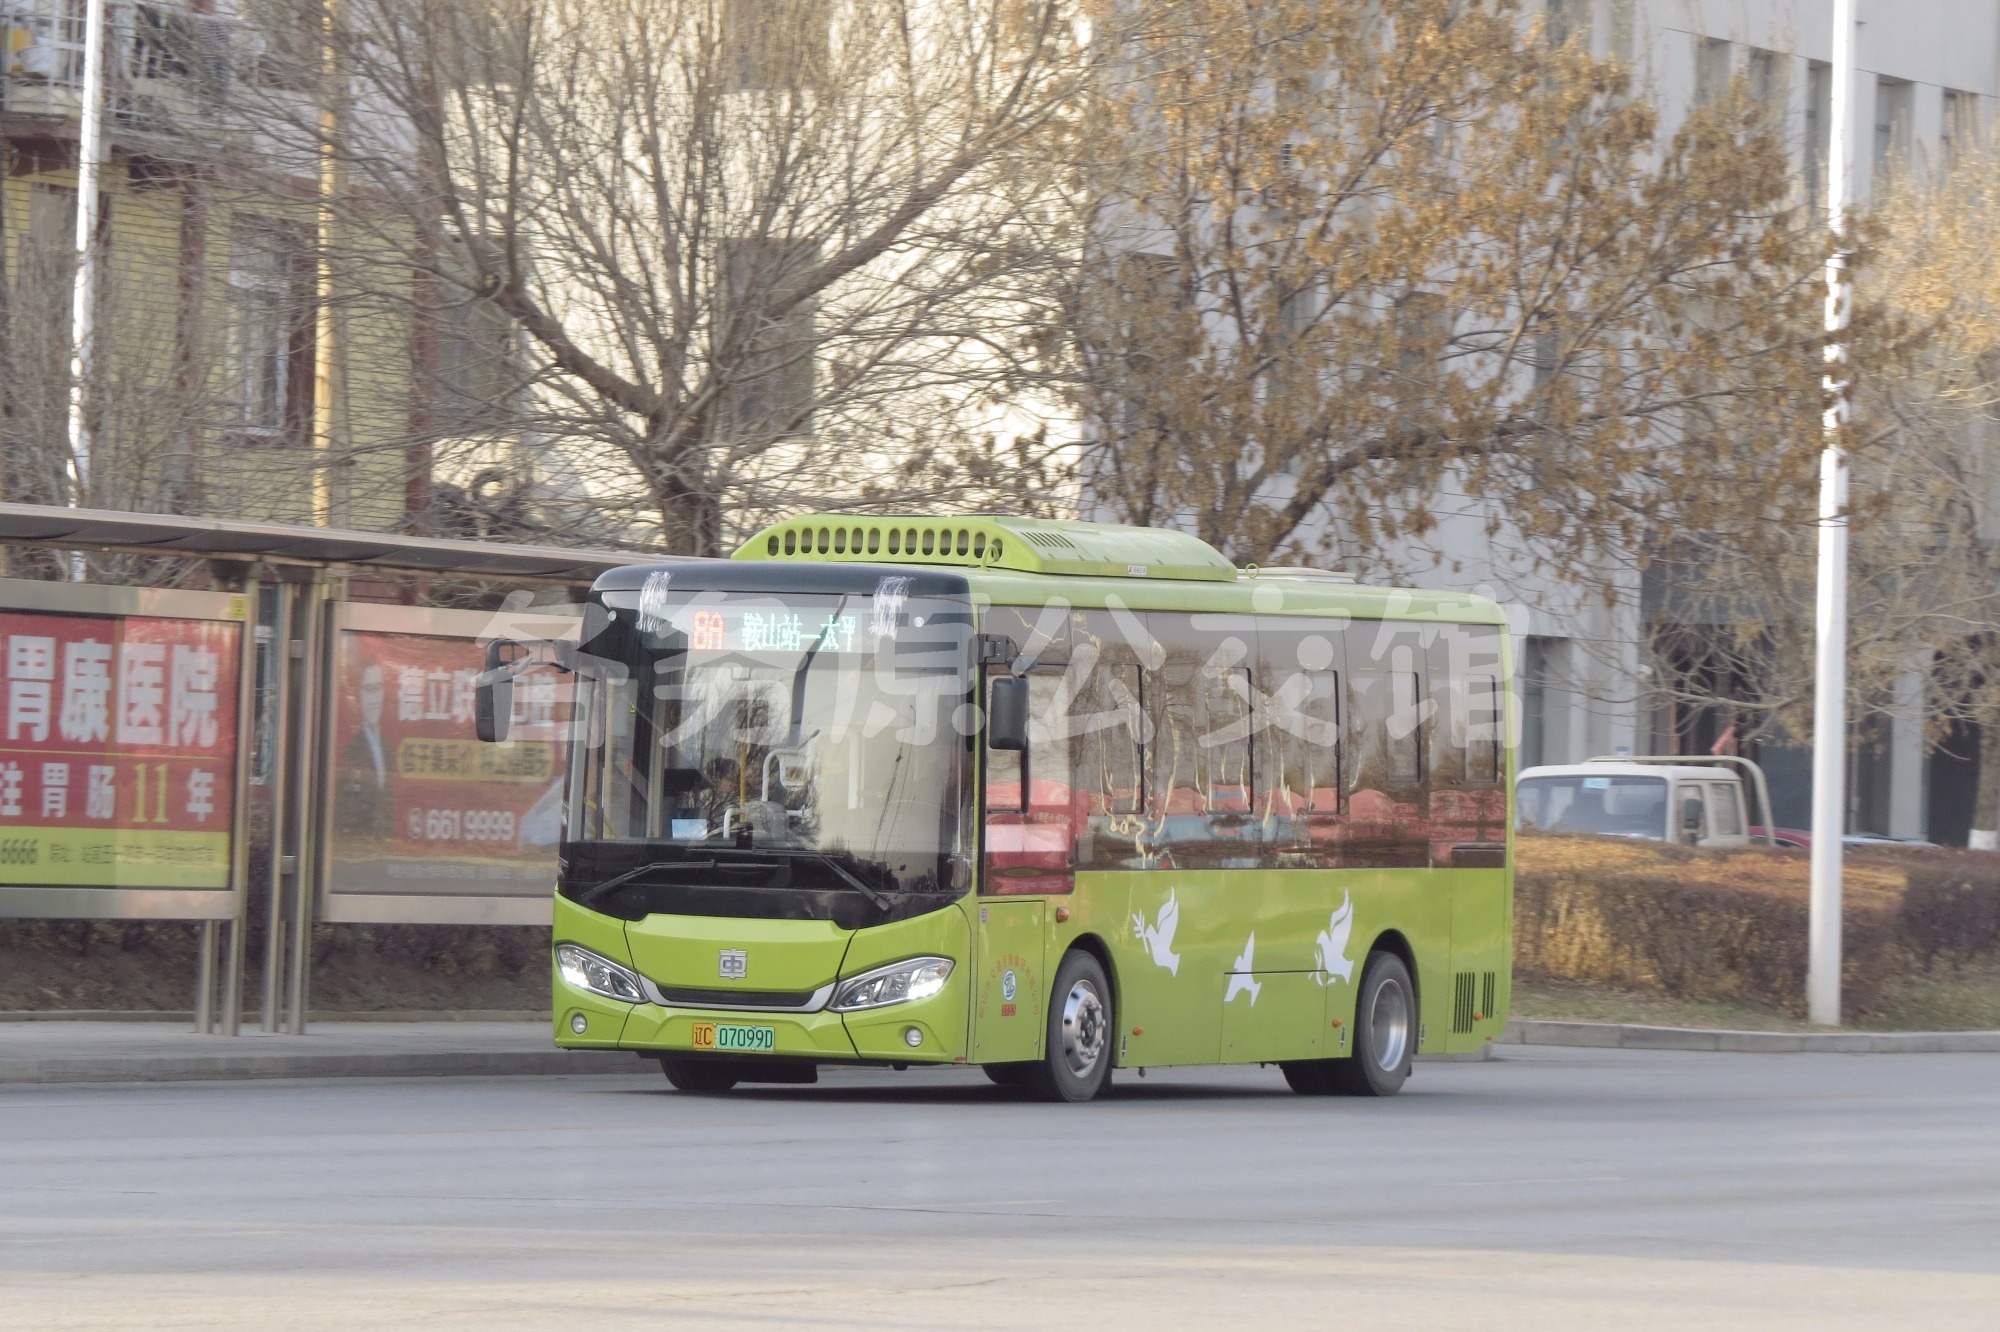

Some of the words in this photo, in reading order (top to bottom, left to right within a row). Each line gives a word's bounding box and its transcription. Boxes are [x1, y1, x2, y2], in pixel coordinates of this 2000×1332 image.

[693, 610, 724, 650] 8A
[6, 634, 220, 748] 胃康医院
[398, 665, 557, 727] 德立联口腔
[426, 808, 461, 840] 661
[463, 809, 516, 841] 9999
[694, 1026, 712, 1045] 辽C
[720, 1028, 773, 1048] 07099D
